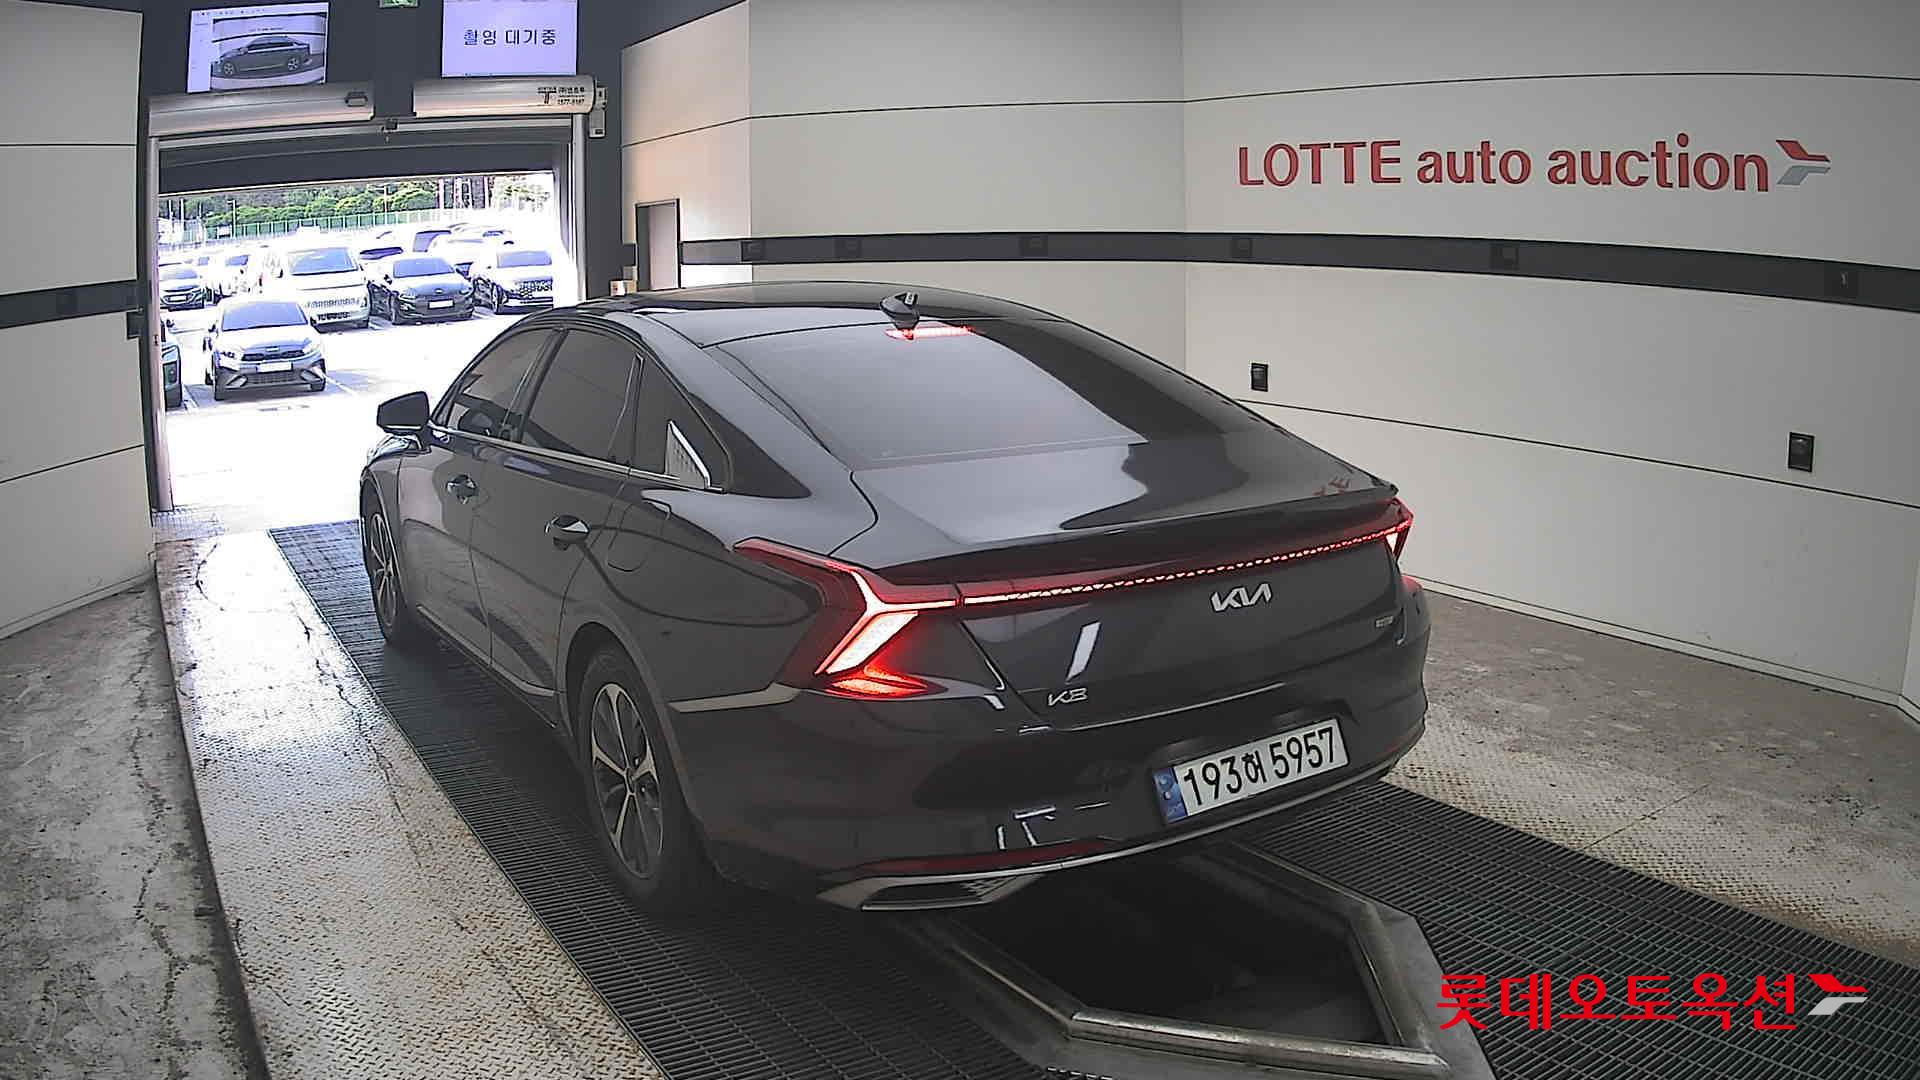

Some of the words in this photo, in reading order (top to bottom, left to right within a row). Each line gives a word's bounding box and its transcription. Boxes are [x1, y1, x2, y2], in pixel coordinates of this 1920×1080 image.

[505, 29, 557, 46] 대기중
[1238, 140, 1402, 186] LOTTE
[1416, 141, 1532, 185] auto
[1548, 133, 1769, 193] auction
[1211, 583, 1272, 612] KIA
